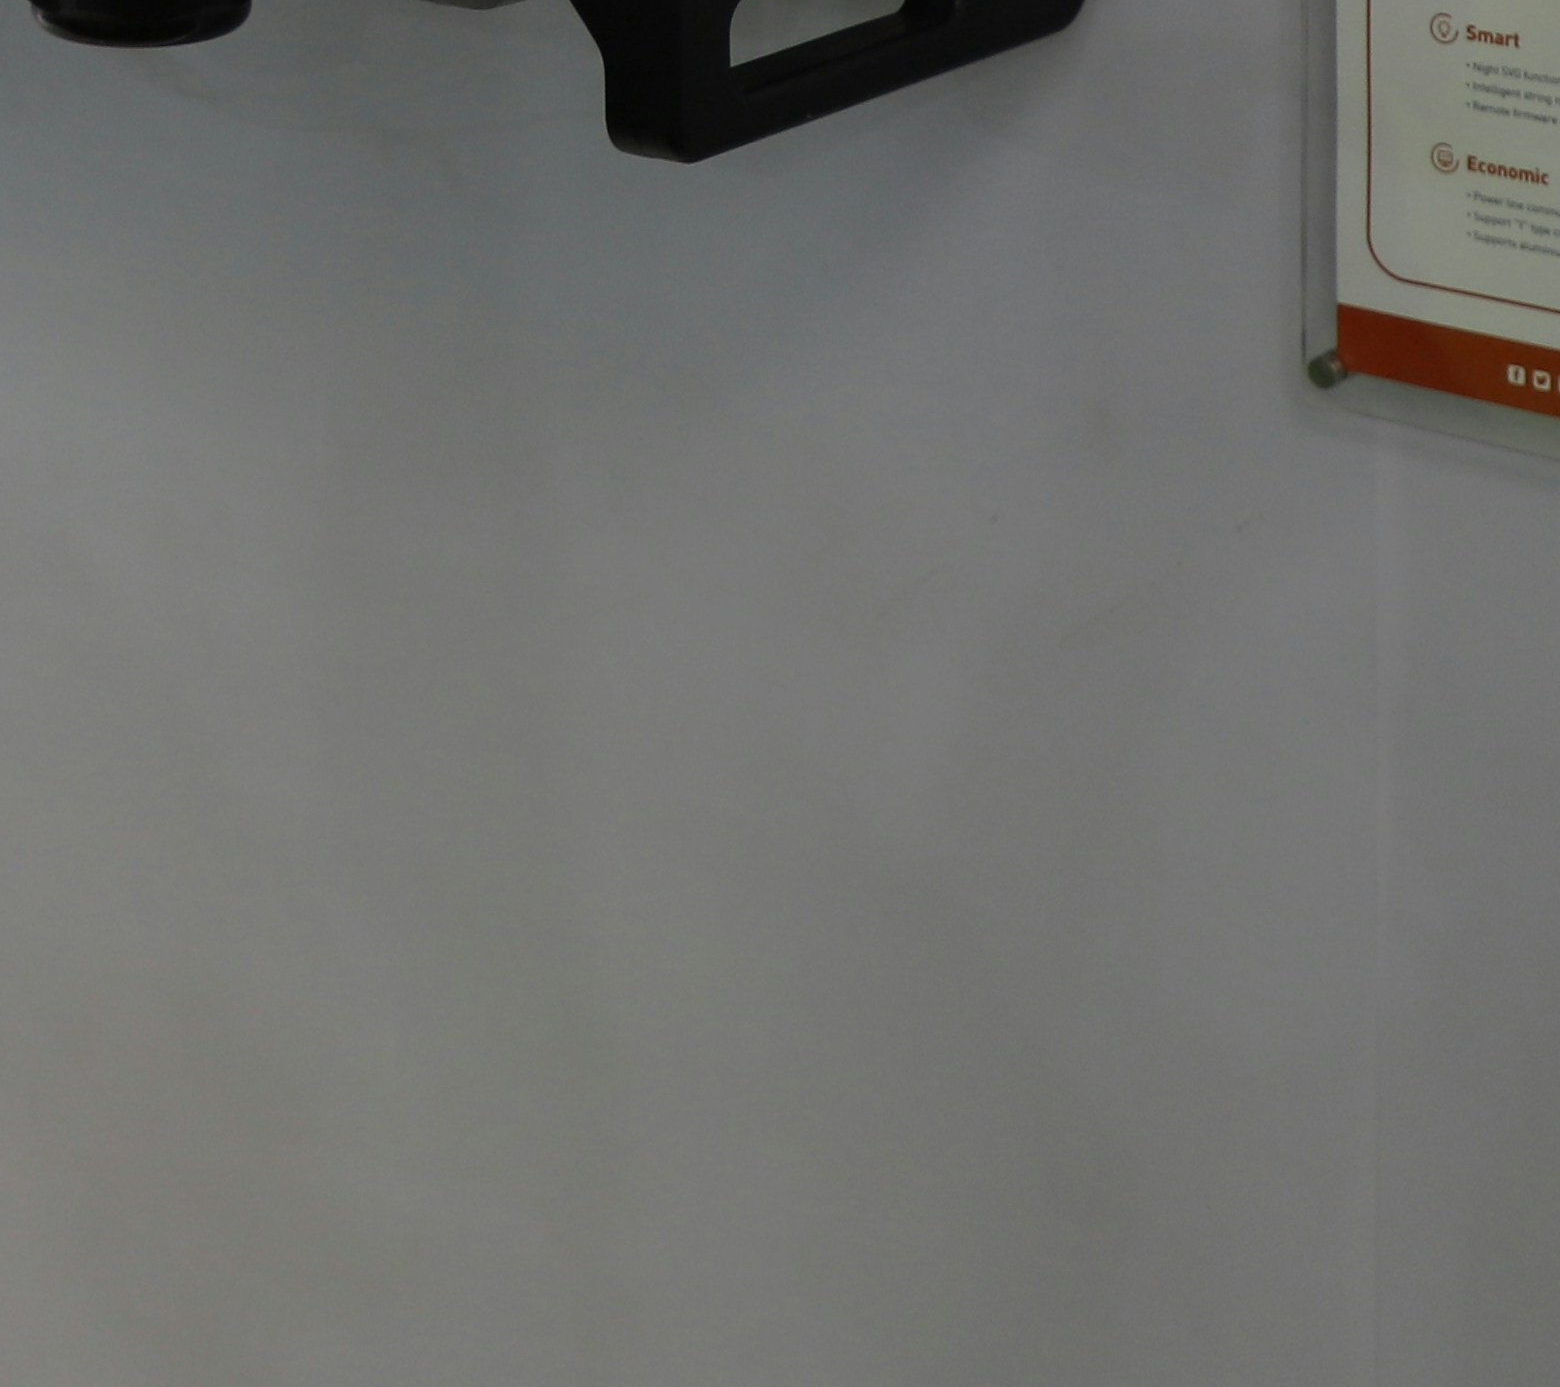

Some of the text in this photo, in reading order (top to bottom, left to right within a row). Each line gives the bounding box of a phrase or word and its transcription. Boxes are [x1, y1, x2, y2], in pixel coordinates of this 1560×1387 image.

[1466, 25, 1520, 48] Smart
[1472, 81, 1521, 98] Intelligent
[1523, 90, 1552, 105] string
[1472, 100, 1511, 116] Remote
[1513, 107, 1558, 124] firmware
[1466, 155, 1550, 186] Economic
[1473, 190, 1503, 205] Power
[1506, 198, 1524, 210] line
[1473, 210, 1511, 227] Support
[1530, 222, 1551, 236] type
[1473, 229, 1517, 248] Supports
